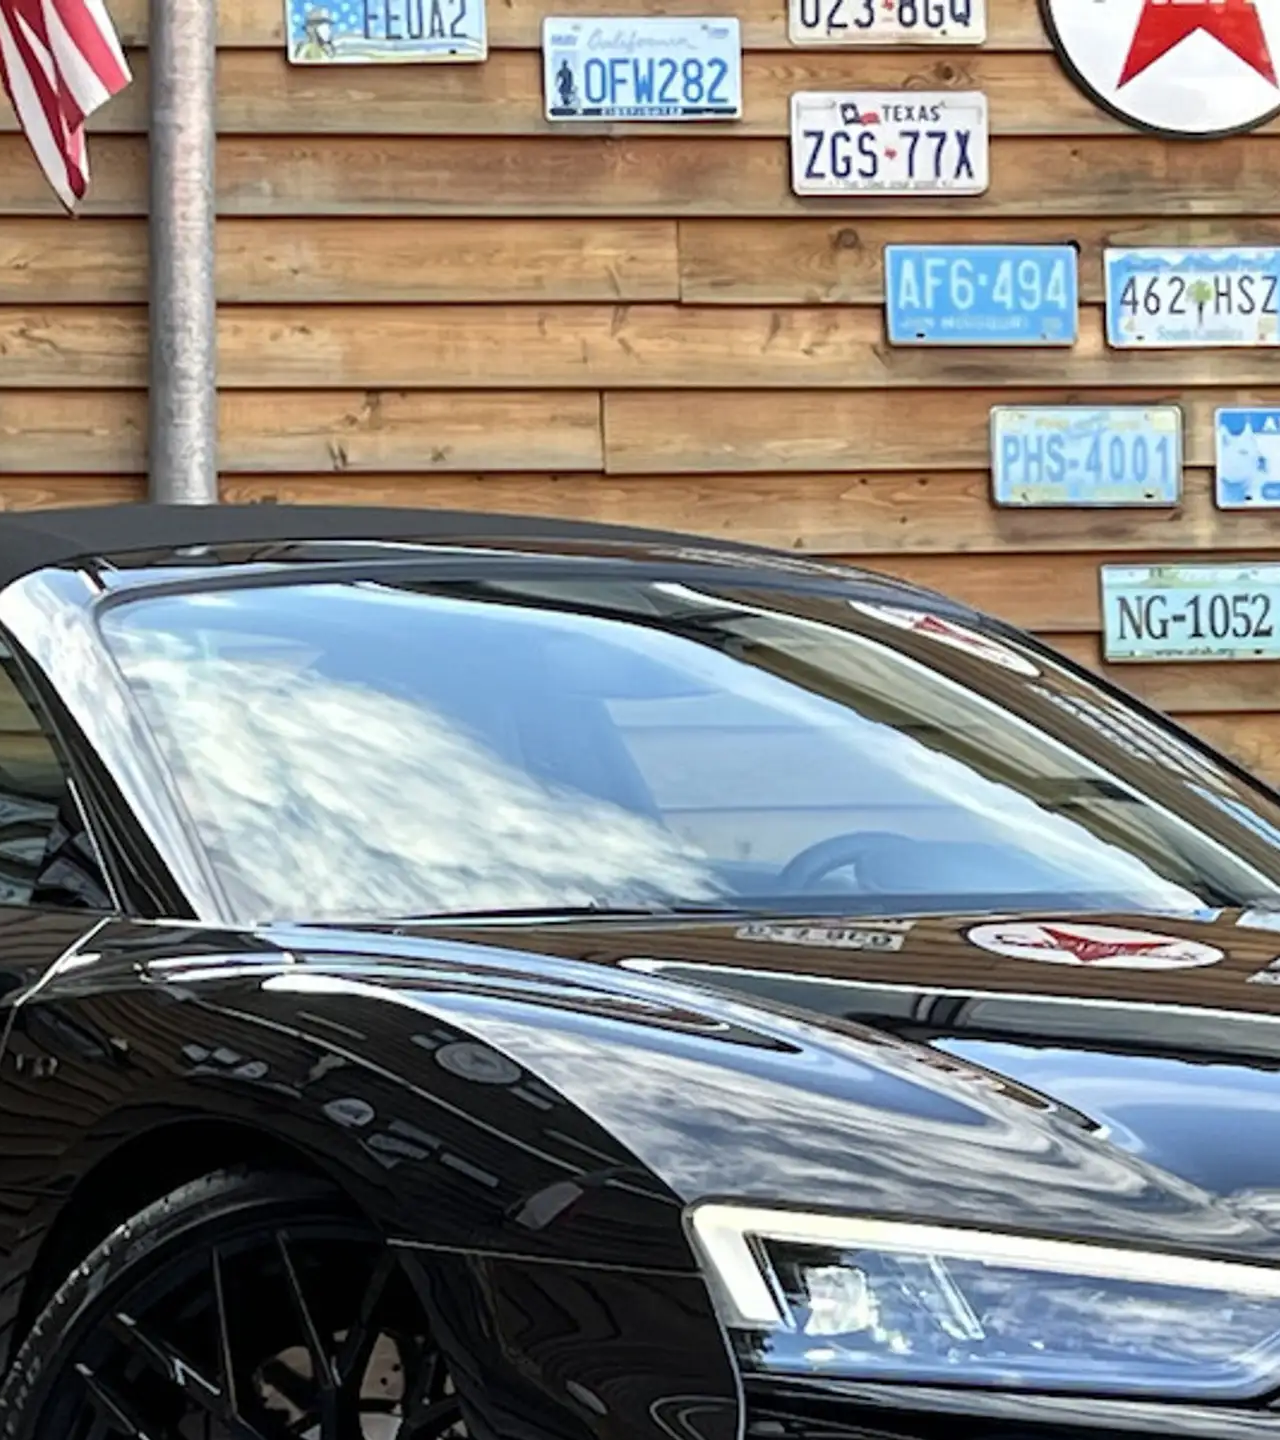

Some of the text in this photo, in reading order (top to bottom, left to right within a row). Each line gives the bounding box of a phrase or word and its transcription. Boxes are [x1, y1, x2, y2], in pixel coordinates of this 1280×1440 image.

[882, 105, 942, 122] TEXAS
[803, 130, 974, 179] ZGS 77X
[1120, 274, 1280, 316] 462 HSZ
[1003, 434, 1169, 483] PHS-4001
[1117, 592, 1274, 640] NG-1052
